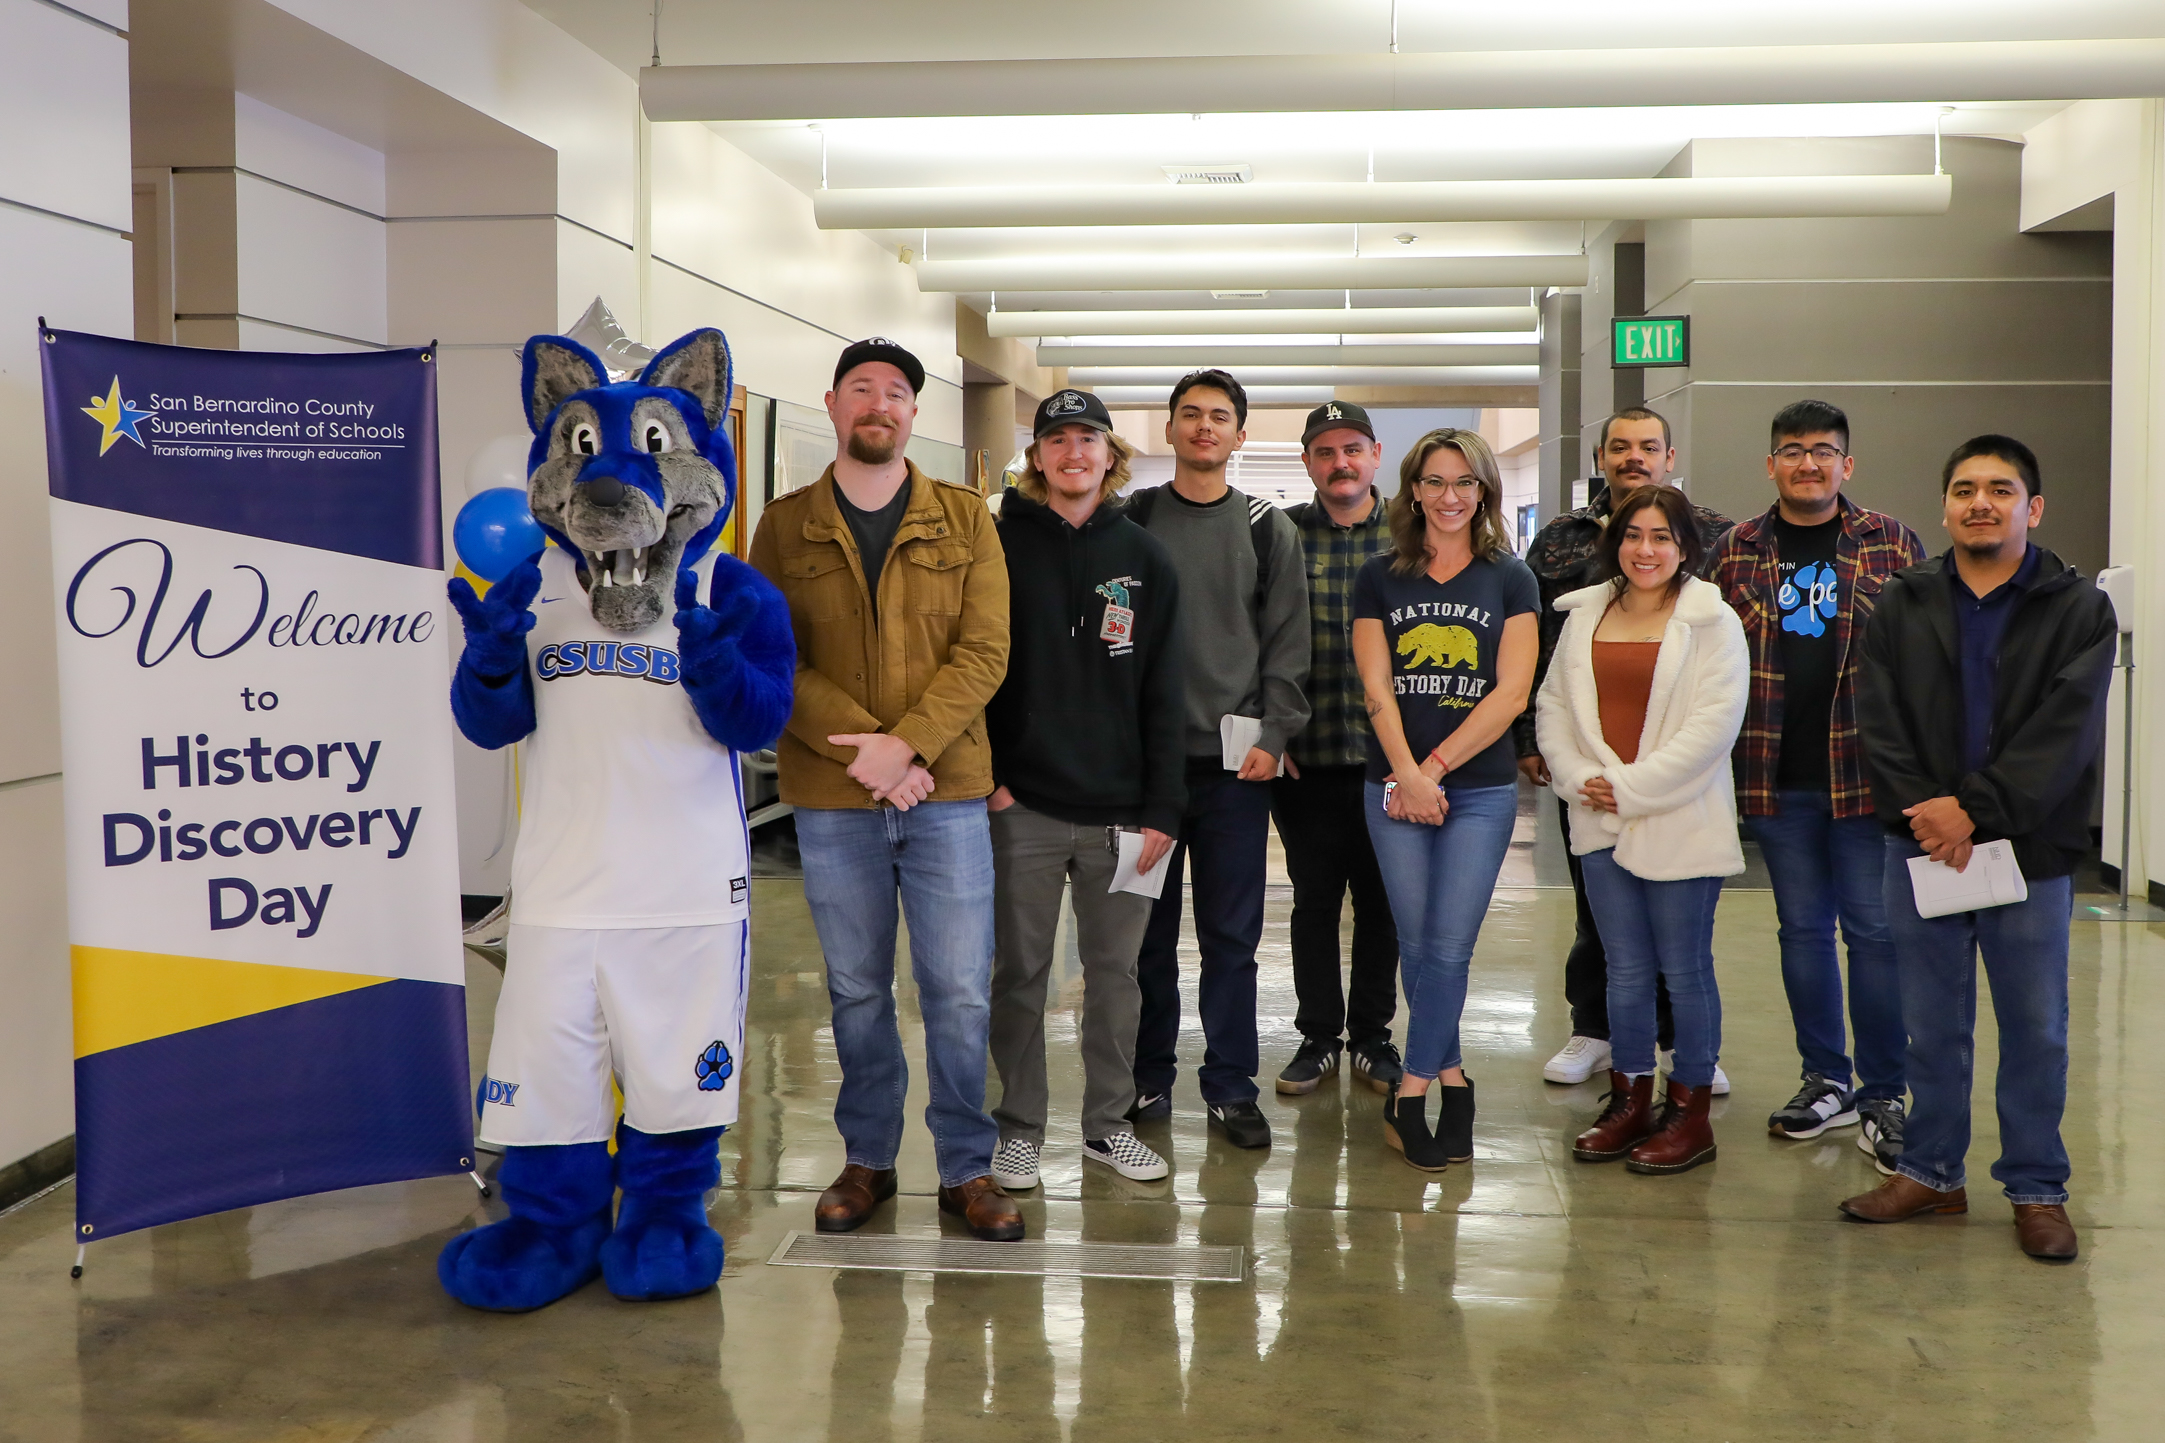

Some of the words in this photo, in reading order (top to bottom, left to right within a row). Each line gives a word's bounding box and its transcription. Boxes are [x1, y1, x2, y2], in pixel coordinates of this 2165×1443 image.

[1625, 324, 1676, 359] EXIT
[150, 393, 187, 410] San
[193, 395, 300, 415] Bernardino
[305, 399, 375, 419] County
[1326, 403, 1343, 421] LA
[151, 417, 300, 437] Superintendent
[305, 421, 325, 437] of
[329, 422, 405, 439] Schools
[152, 444, 233, 460] Transforming
[236, 446, 263, 459] lives
[266, 448, 315, 462] through
[318, 449, 382, 460] education
[66, 538, 435, 668] Welcome
[1390, 603, 1491, 628] NATIONAL
[536, 640, 680, 685] CSUSB
[1394, 674, 1453, 695] STORY
[1456, 676, 1487, 698] DAY
[240, 687, 279, 712] to
[141, 733, 382, 793] History
[103, 806, 423, 867] Discovery
[732, 880, 746, 889] 3XL
[208, 877, 333, 938] Day
